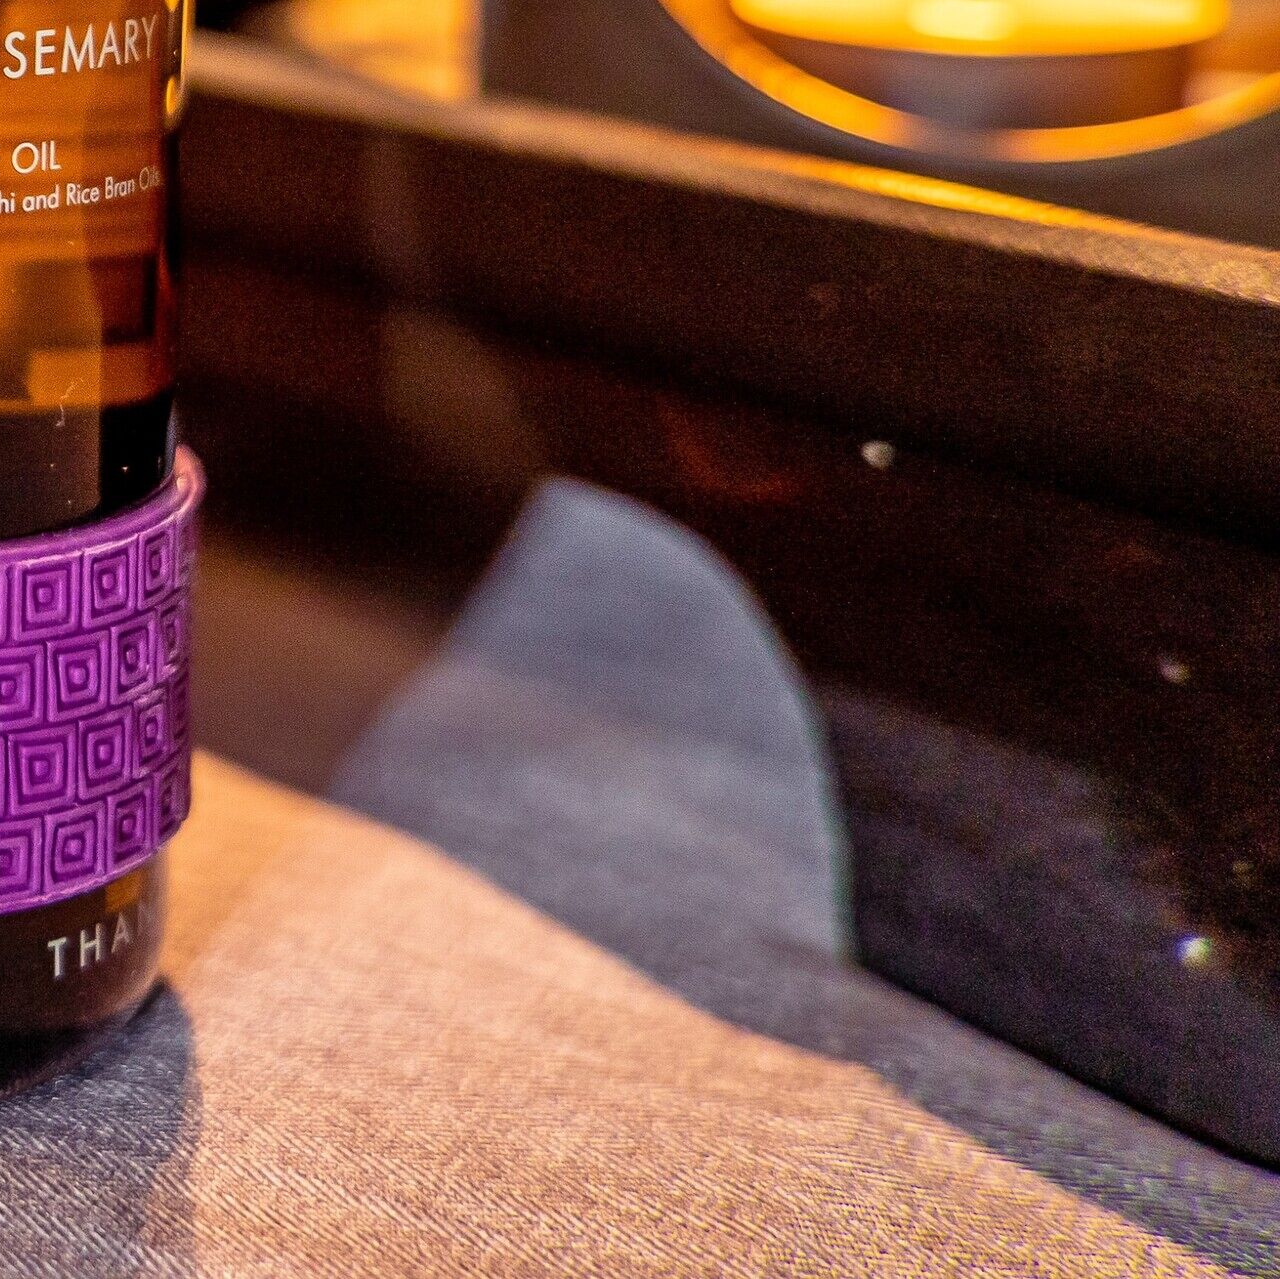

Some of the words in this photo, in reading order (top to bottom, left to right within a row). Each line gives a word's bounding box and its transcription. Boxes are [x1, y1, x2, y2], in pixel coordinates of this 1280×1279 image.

[11, 140, 62, 174] OIL
[22, 184, 60, 213] and
[66, 182, 100, 207] Rice
[105, 176, 135, 200] Bran
